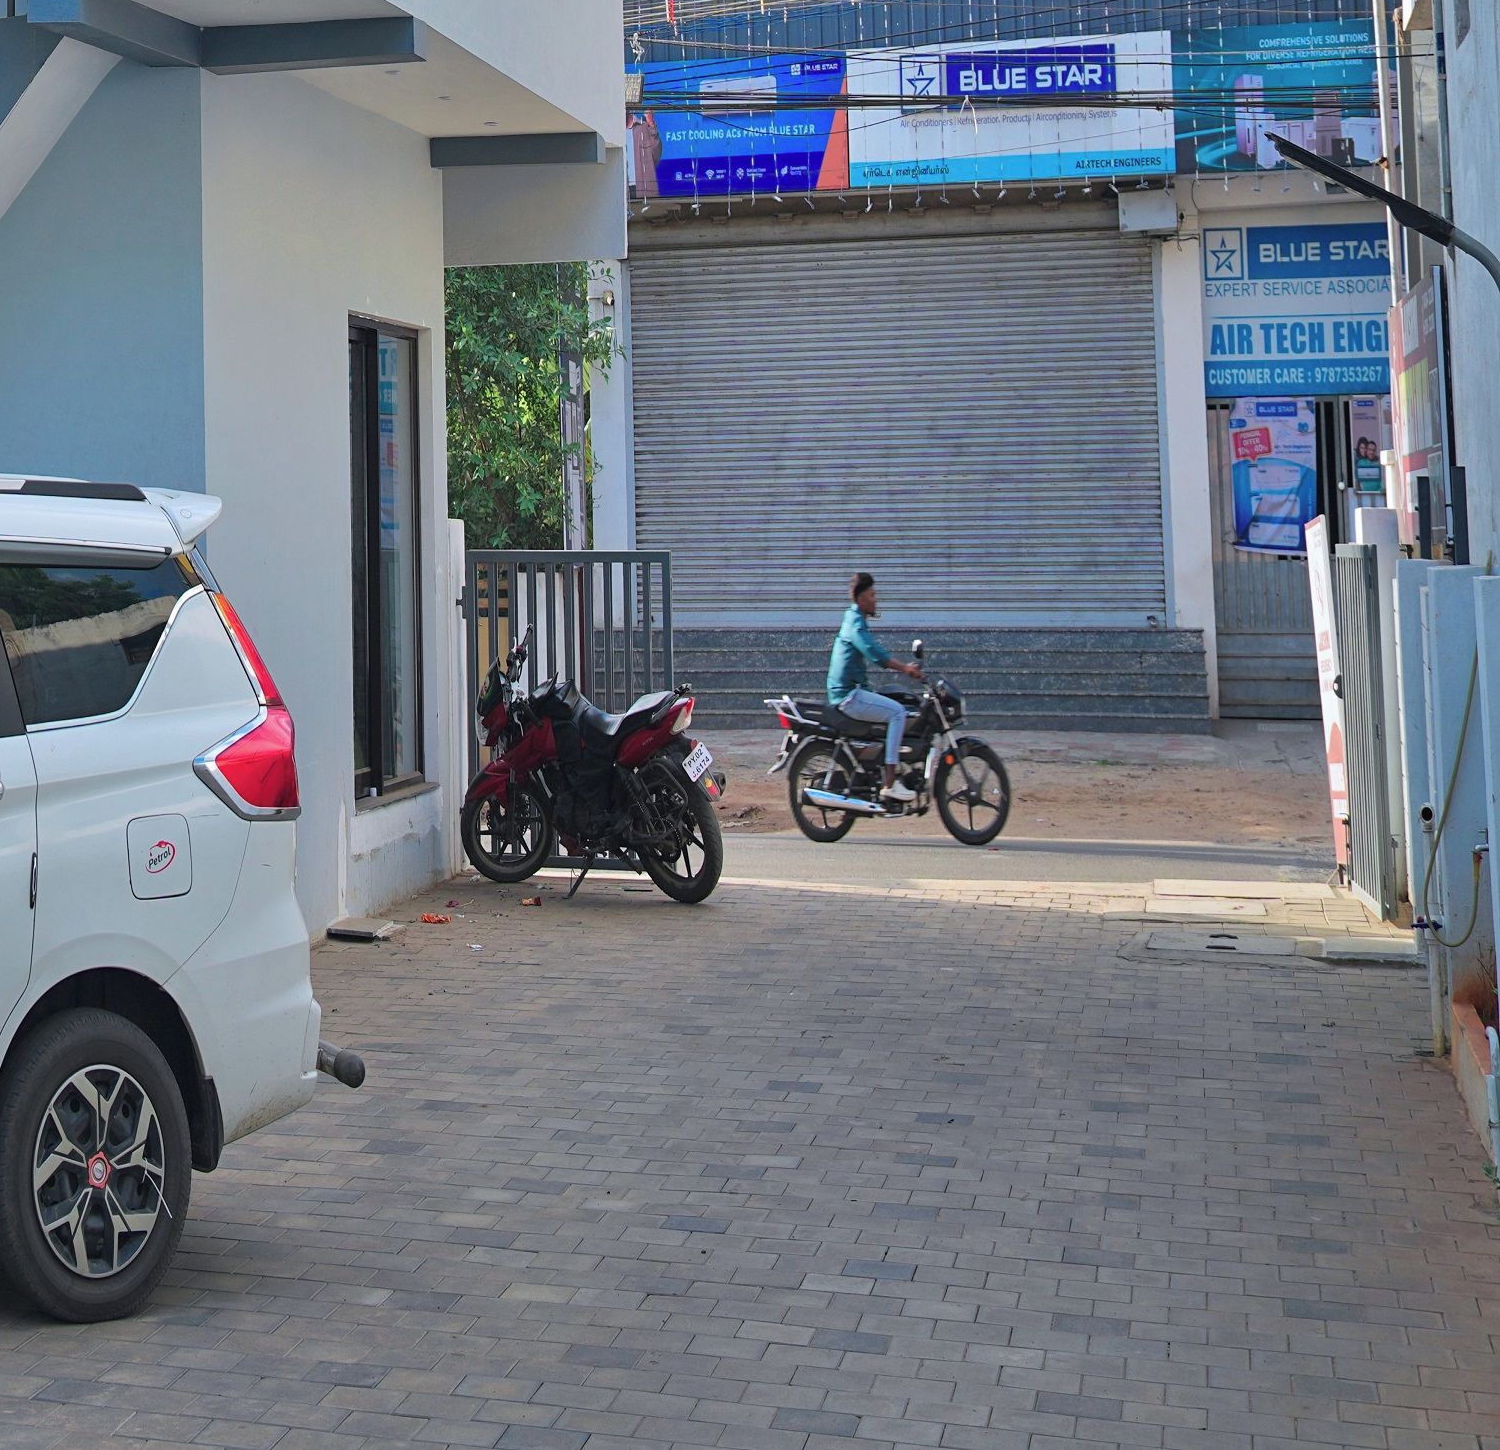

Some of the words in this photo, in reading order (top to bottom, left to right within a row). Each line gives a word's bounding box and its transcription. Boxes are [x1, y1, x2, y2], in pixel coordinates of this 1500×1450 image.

[1259, 35, 1323, 48] COMPREHENSIVE
[1325, 32, 1369, 44] SOLUTIONS
[1246, 51, 1261, 61] FOR
[1263, 49, 1294, 60] DIVERSE
[959, 67, 1026, 92] BLUE
[1035, 64, 1102, 88] STAR
[901, 119, 909, 128] Air
[911, 116, 953, 128] Conditioners
[1002, 111, 1032, 123] Products
[666, 130, 687, 142] FAST
[689, 129, 724, 141] COOLING
[726, 128, 742, 139] ACs
[743, 127, 767, 137] FROM
[769, 125, 791, 136] BLUE
[792, 124, 815, 135] STAR
[1075, 158, 1112, 170] AIRTECH
[1114, 156, 1162, 168] ENGINEERS
[1259, 241, 1321, 263] BLUE
[1328, 239, 1390, 261] STAR
[1205, 281, 1259, 297] EXPERT
[1263, 279, 1323, 296] SERVICE
[1210, 323, 1253, 355] AIR
[1260, 321, 1325, 355] TECH
[1209, 367, 1271, 385] CUSTOMER
[1274, 366, 1305, 384] CARE
[1315, 365, 1382, 383] 9787353267
[687, 748, 704, 768] PY.02
[148, 846, 171, 869] Petrol
